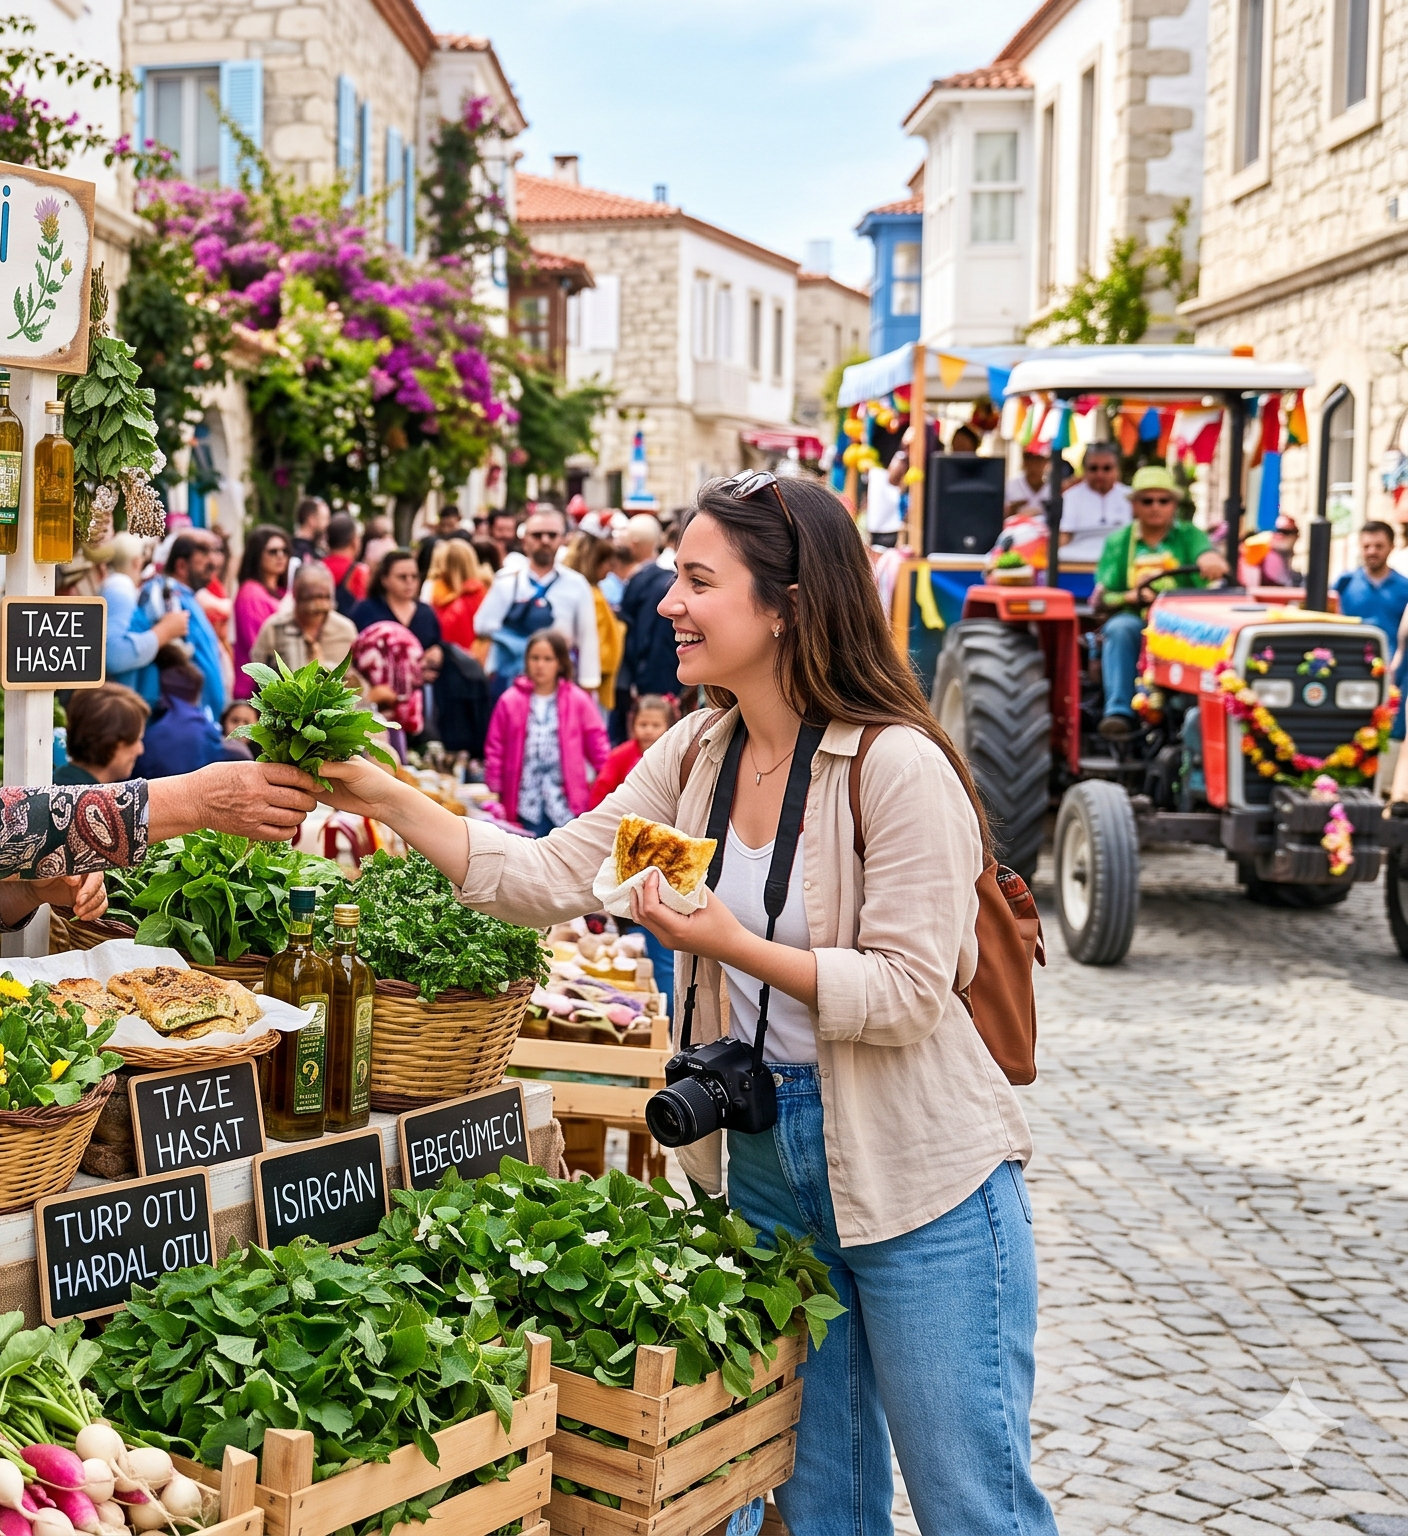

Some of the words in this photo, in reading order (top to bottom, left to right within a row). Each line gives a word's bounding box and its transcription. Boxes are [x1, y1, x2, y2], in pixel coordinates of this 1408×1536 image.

[21, 610, 85, 638] TAZE
[15, 645, 92, 672] HASAT
[153, 1074, 234, 1120] TAZE
[155, 1116, 245, 1168] HASAT
[410, 1102, 522, 1178] EBEGÜMECİ
[54, 1201, 132, 1247] TURP
[143, 1186, 196, 1228] OTU
[273, 1162, 376, 1227] ISIRGAN
[53, 1244, 158, 1300] HARDAL
[162, 1230, 209, 1272] OTU
